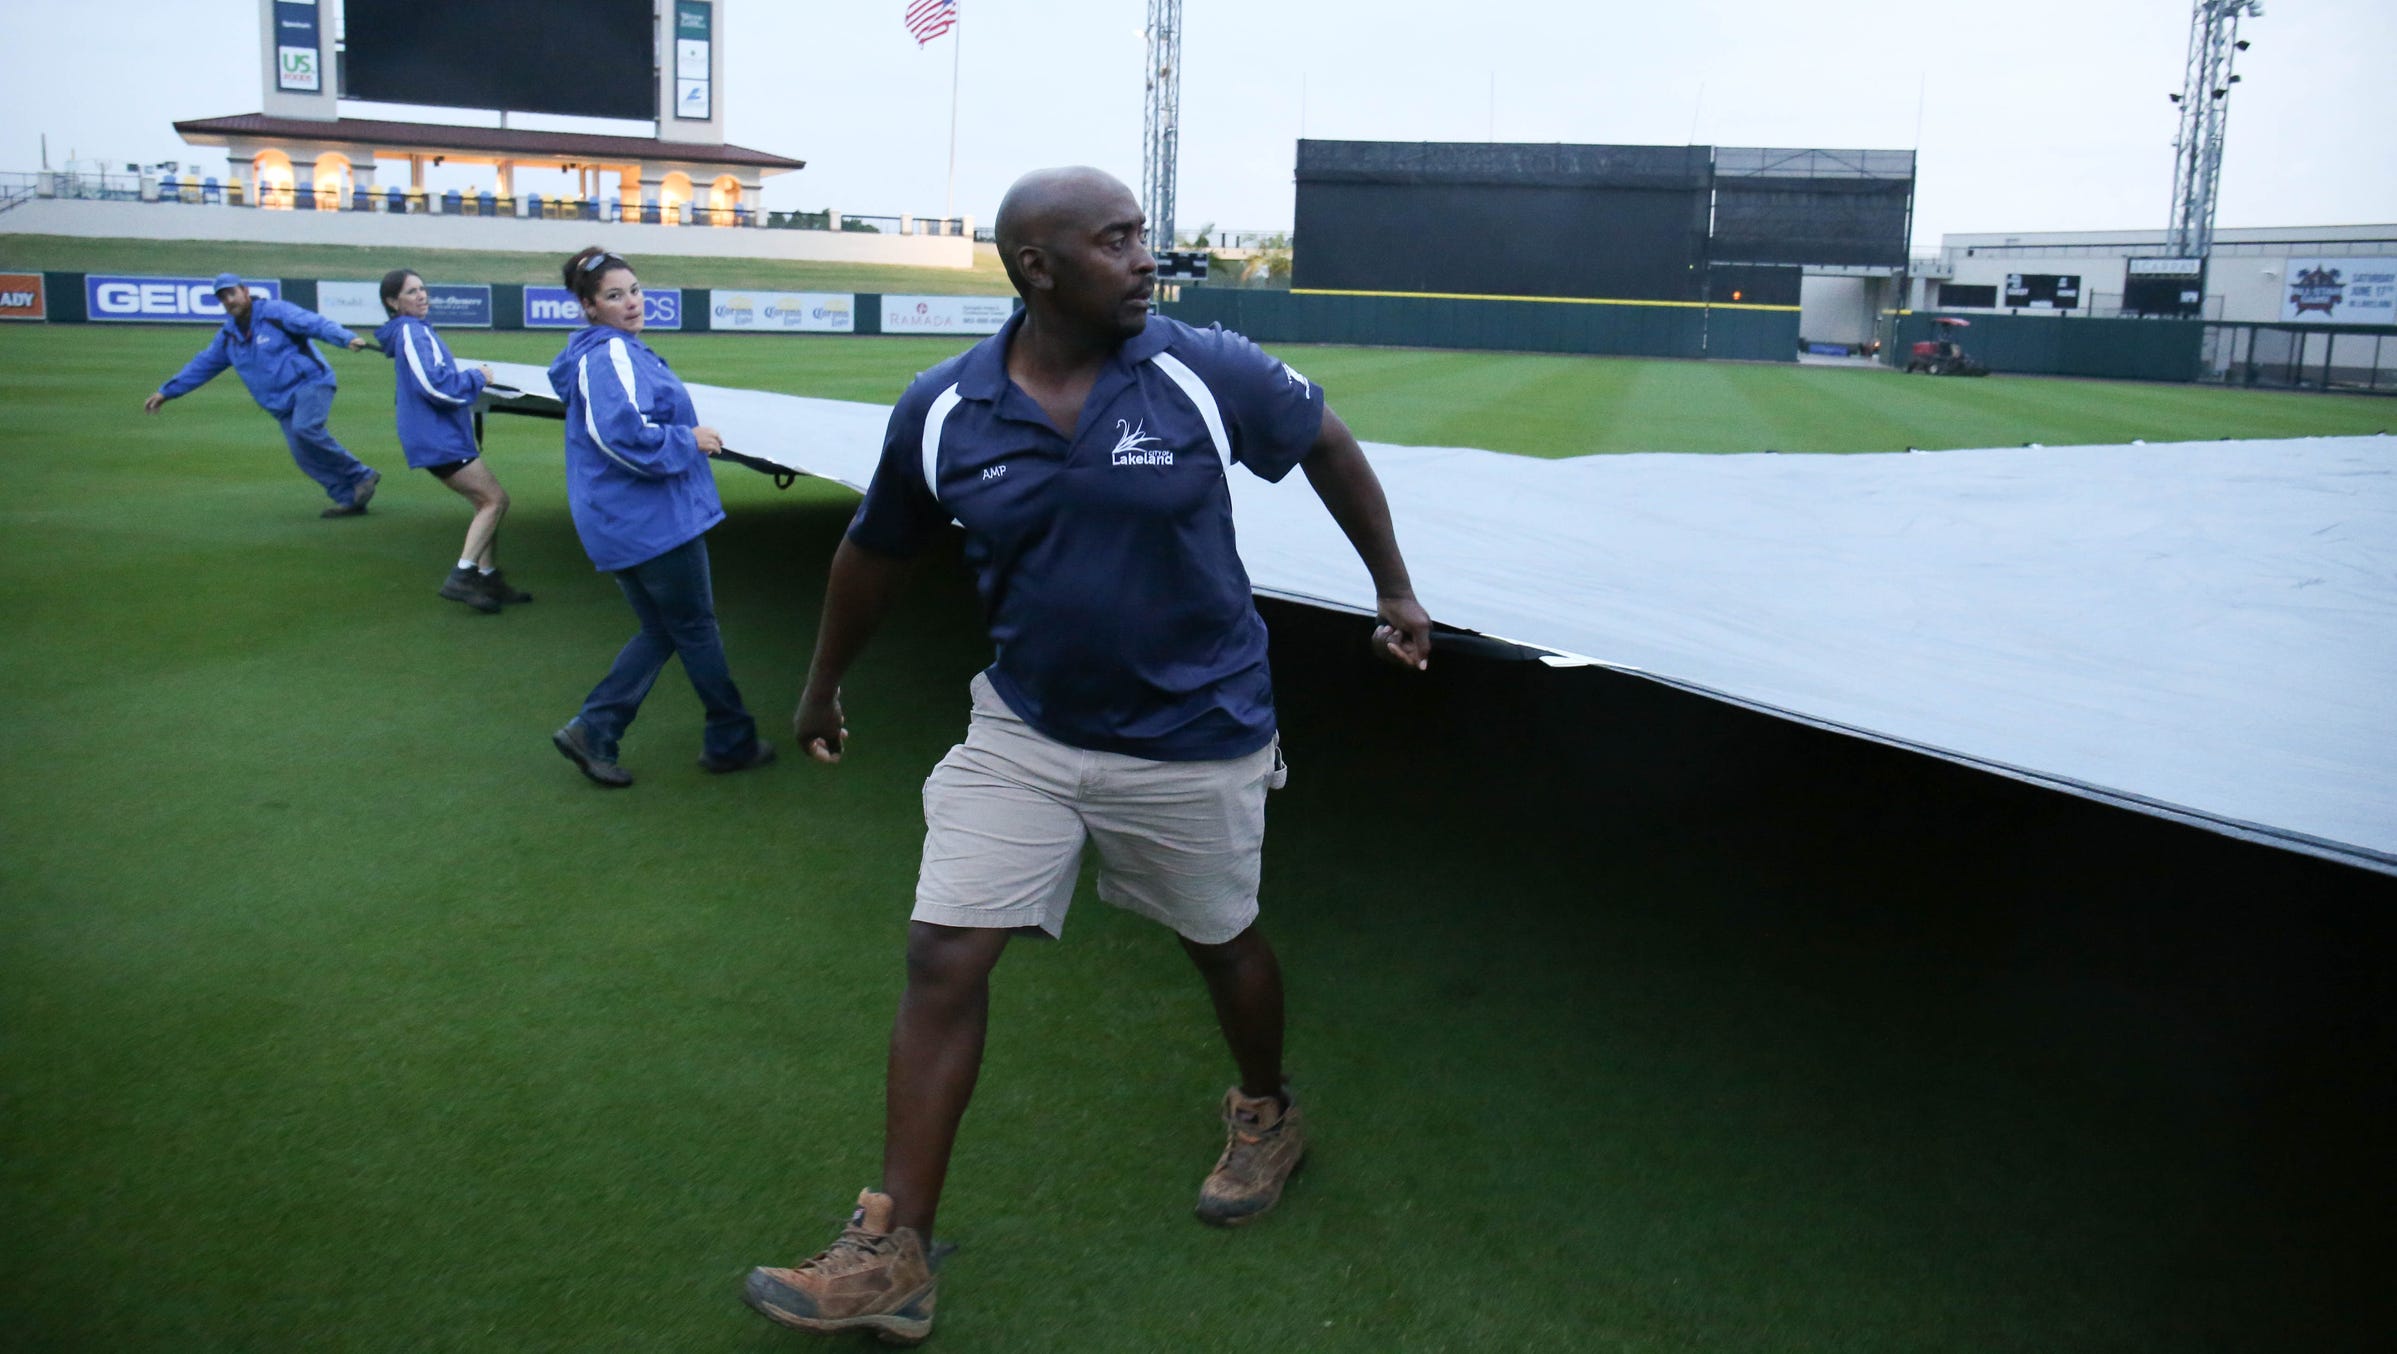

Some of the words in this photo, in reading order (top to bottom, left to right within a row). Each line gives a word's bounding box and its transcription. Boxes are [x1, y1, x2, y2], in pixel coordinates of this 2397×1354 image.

[889, 313, 953, 327] RAMADA
[1112, 452, 1173, 466] Lakeland
[982, 465, 1007, 480] AMP
